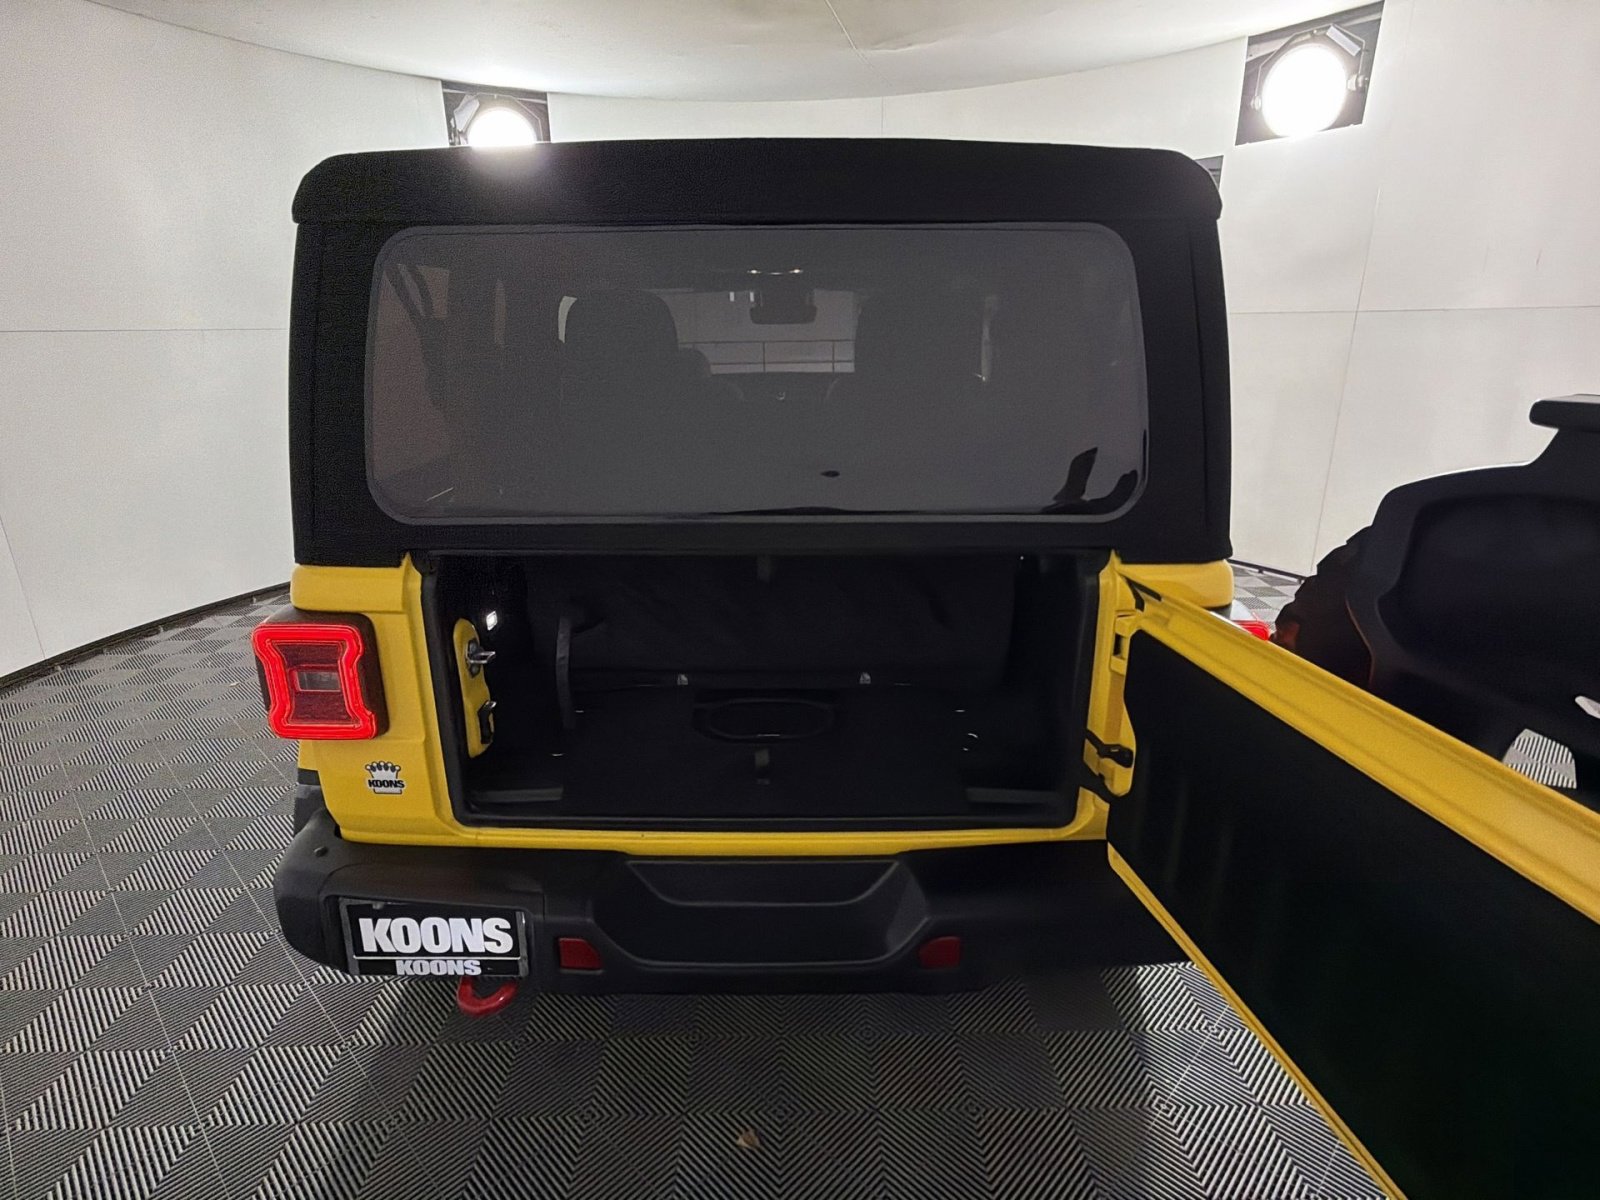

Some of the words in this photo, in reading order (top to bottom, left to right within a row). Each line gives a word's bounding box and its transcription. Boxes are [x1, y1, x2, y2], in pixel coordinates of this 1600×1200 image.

[368, 779, 405, 788] KOONS
[358, 917, 514, 954] KOONS
[395, 959, 482, 976] KOONS
